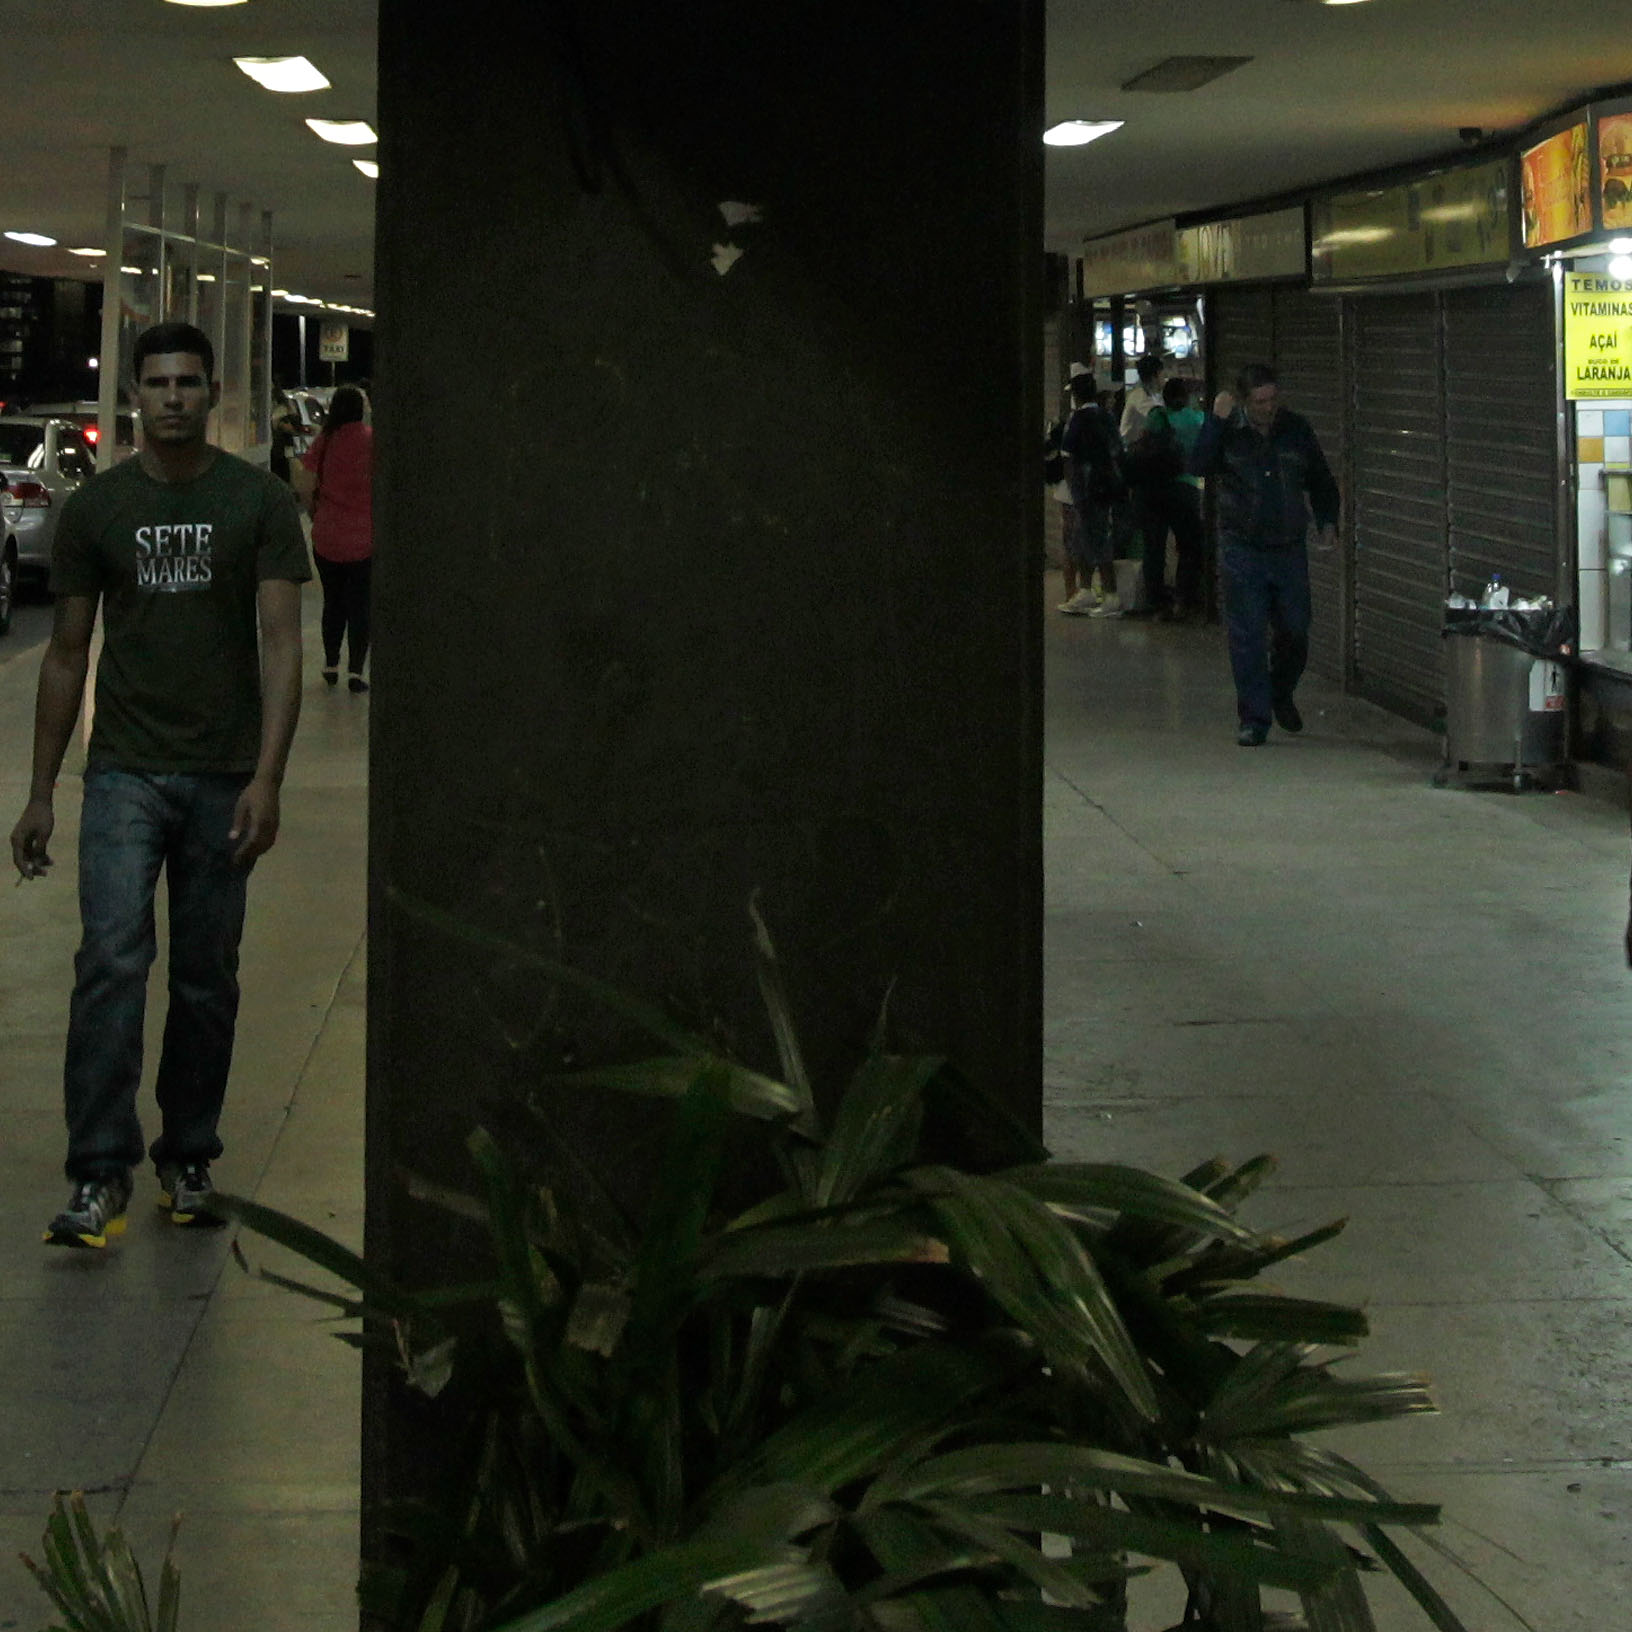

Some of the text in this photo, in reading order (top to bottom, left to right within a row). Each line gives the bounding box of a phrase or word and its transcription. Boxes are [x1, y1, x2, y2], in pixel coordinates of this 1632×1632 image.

[1590, 329, 1618, 352] AÇAÍ
[1576, 366, 1631, 381] LARANJA
[135, 523, 213, 558] SETE
[136, 556, 212, 585] MARES
